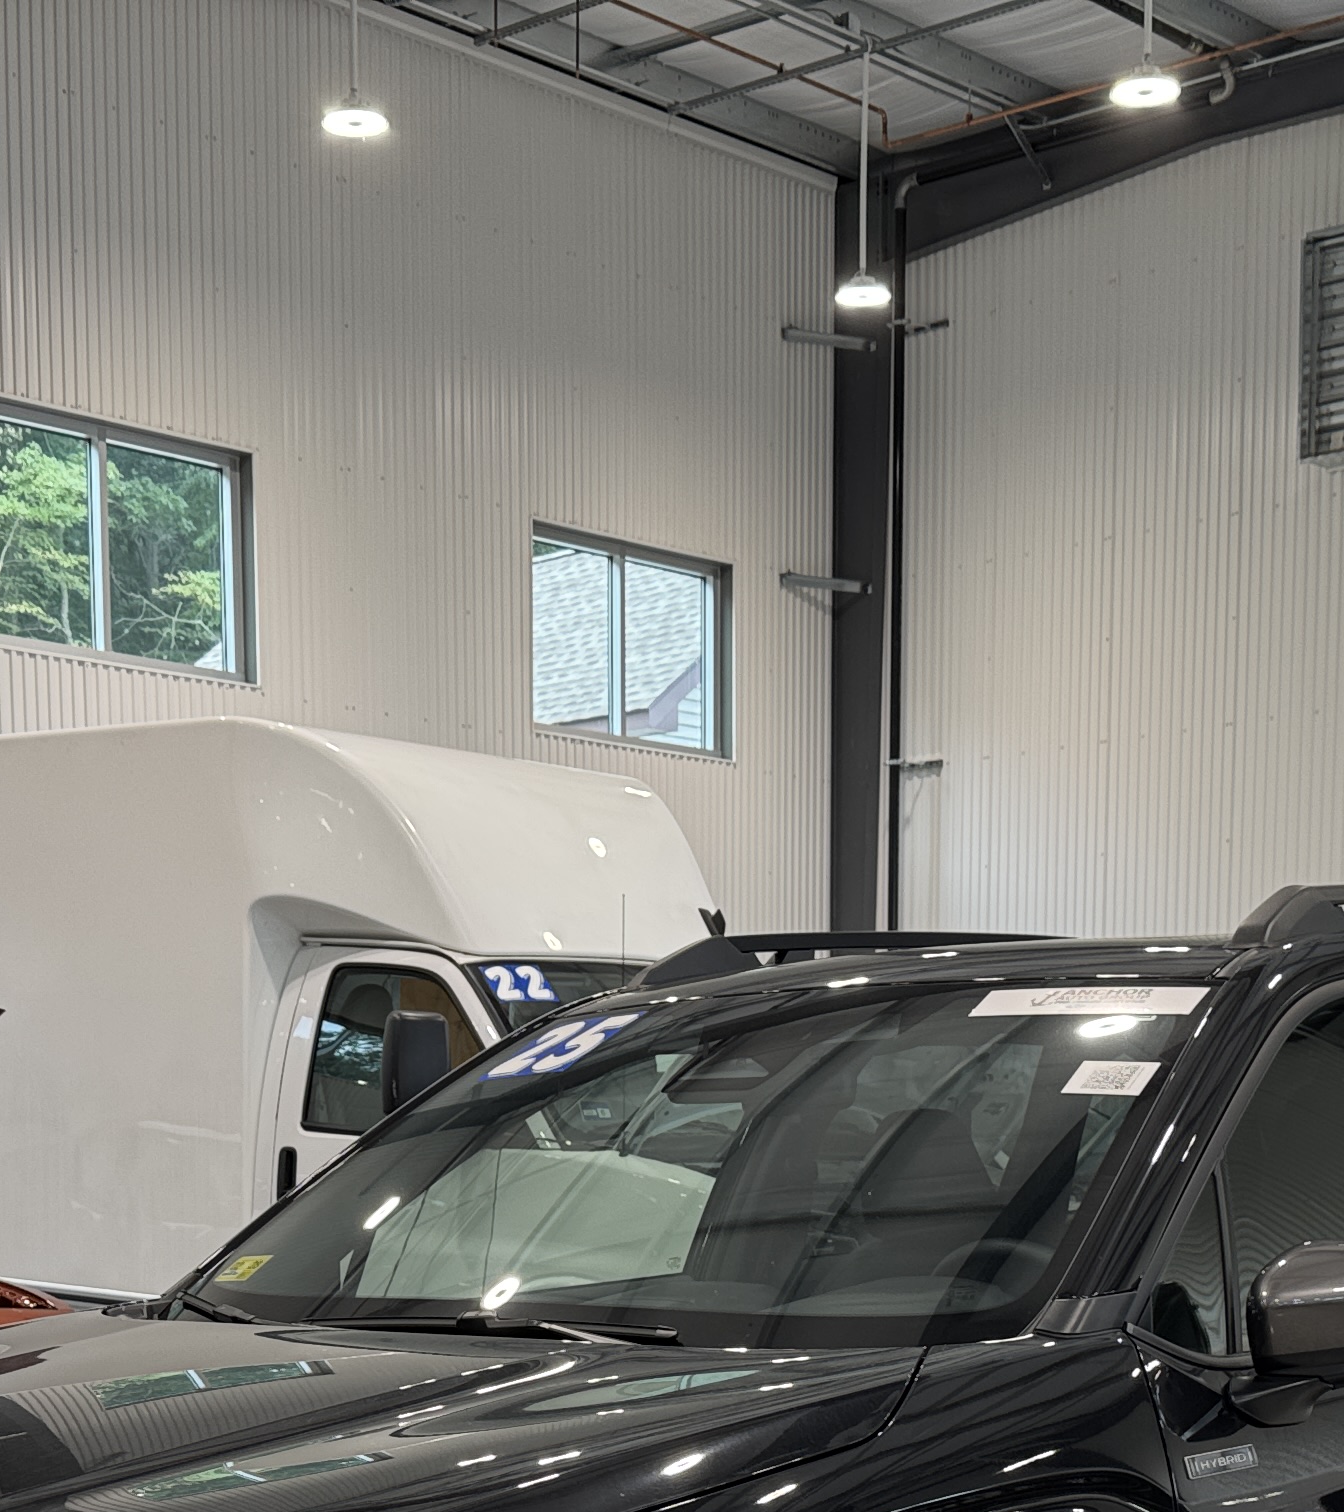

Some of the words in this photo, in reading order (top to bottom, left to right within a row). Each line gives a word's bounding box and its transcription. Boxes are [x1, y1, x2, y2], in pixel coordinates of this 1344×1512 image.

[484, 965, 556, 1000] 22
[1062, 988, 1154, 997] ANCHOR
[487, 1013, 640, 1078] 25
[1200, 1453, 1247, 1470] HYBRID
